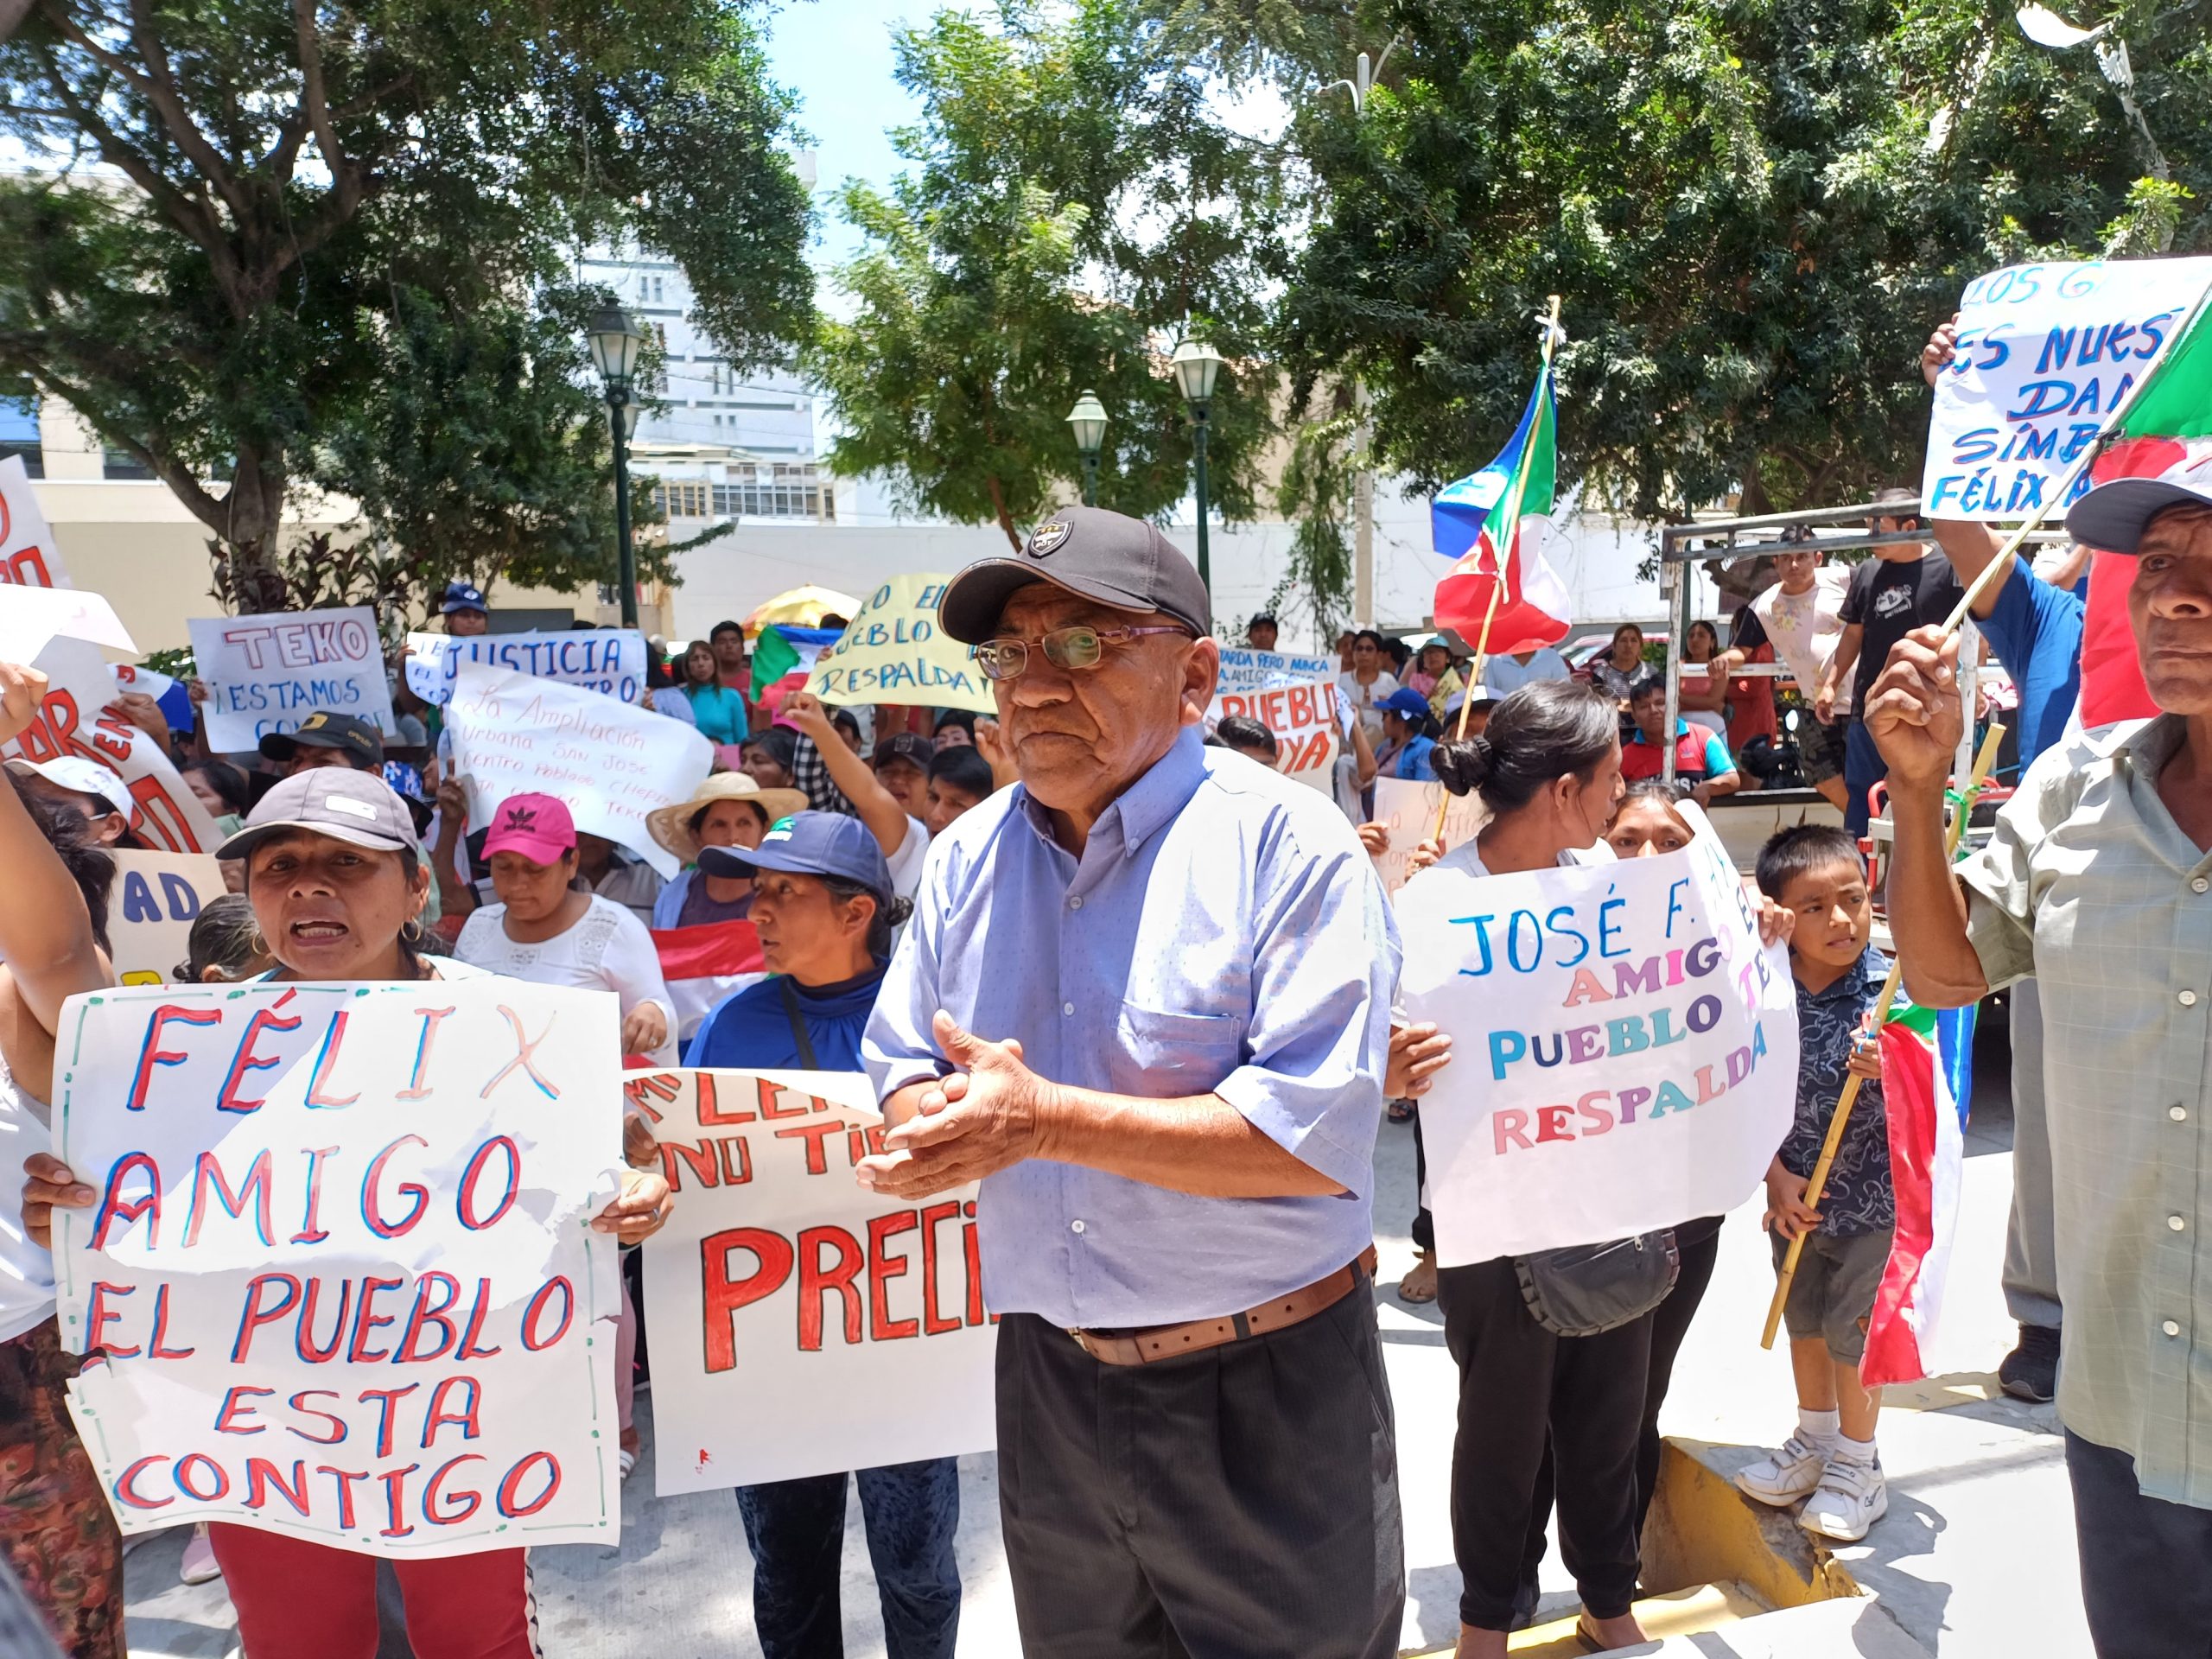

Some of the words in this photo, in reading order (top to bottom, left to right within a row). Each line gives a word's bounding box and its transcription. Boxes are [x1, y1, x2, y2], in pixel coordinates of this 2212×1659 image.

[1961, 266, 2044, 306] LOS
[2034, 306, 2186, 375] NUES
[1952, 422, 2101, 465] SÍMB
[224, 619, 369, 670] TEKO
[1257, 652, 1285, 671] PERO
[1289, 658, 1329, 673] NUNCA
[1448, 883, 1632, 976] JOSÉ
[1562, 924, 1733, 1008] AMIGO
[126, 988, 562, 1113] FÉLIX
[1488, 994, 1723, 1081] PUEBLO
[1492, 1020, 1768, 1156] RESPALDA
[85, 1134, 521, 1251] AMIGO
[657, 1135, 753, 1193] NO
[85, 1281, 195, 1360] EL
[230, 1270, 574, 1363] PUEBLO
[213, 1376, 480, 1459] ESTA
[113, 1451, 563, 1537] CONTIGO
